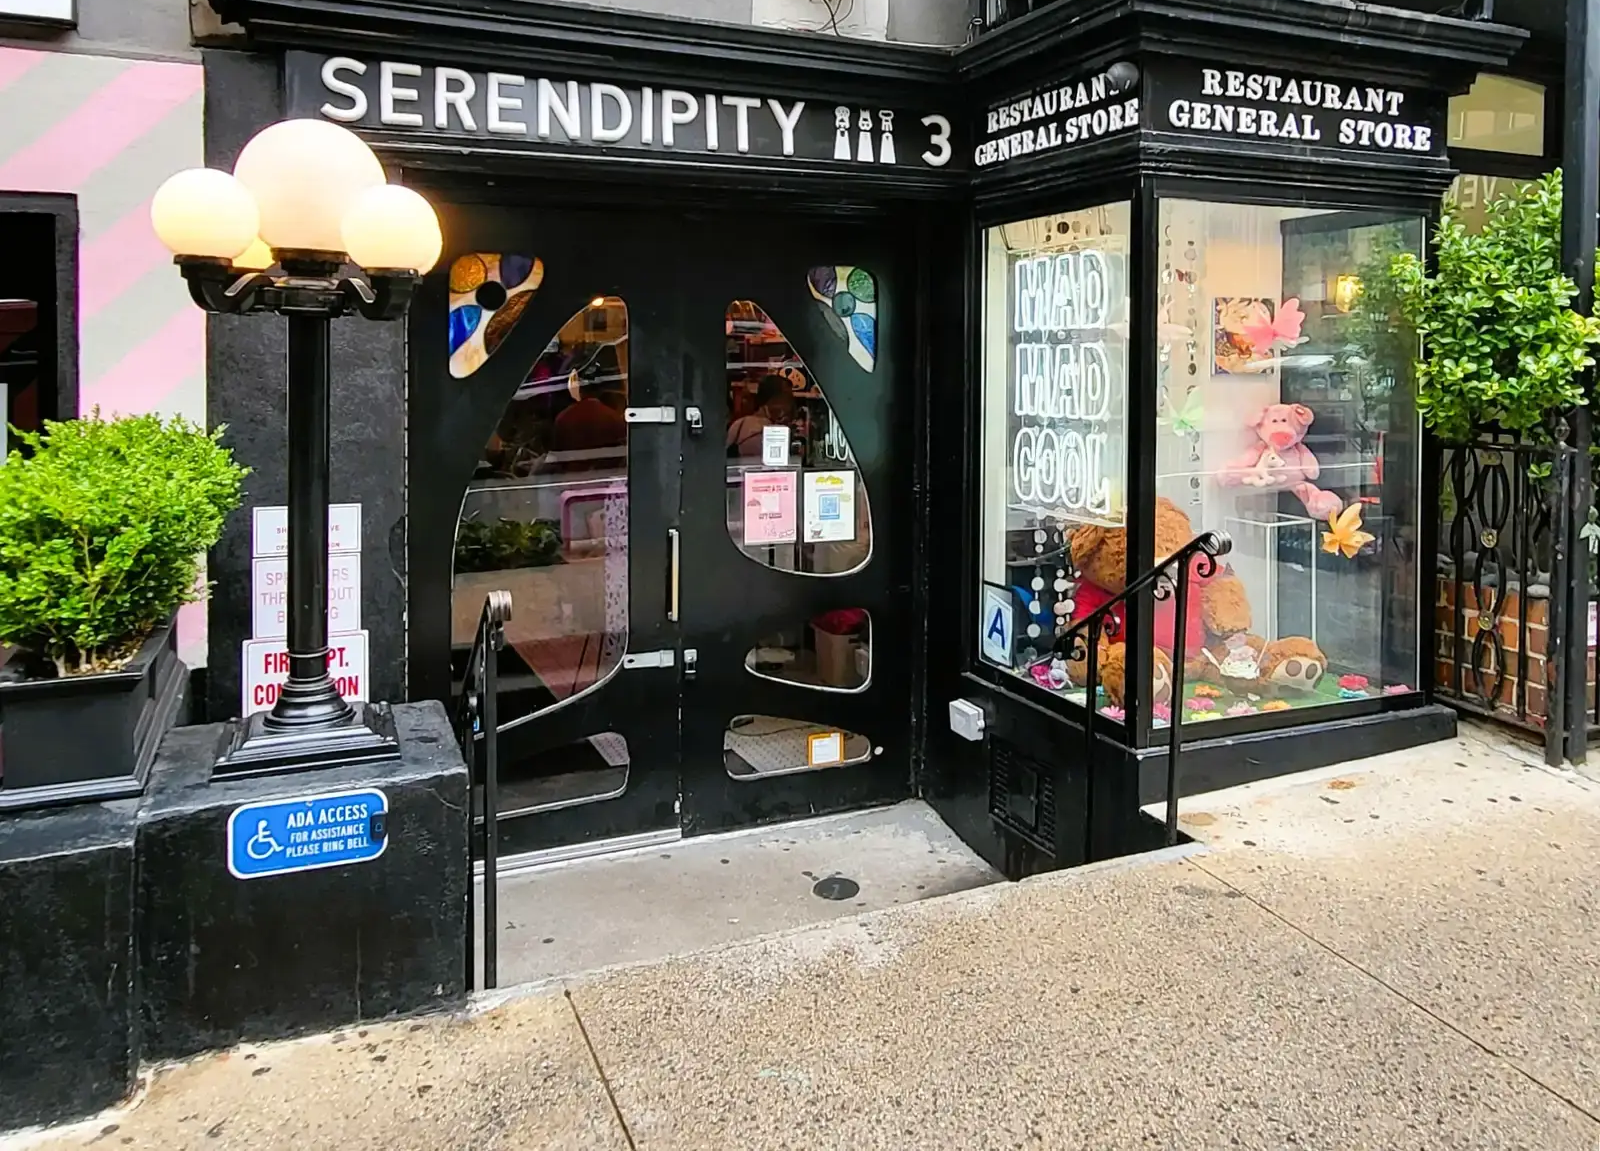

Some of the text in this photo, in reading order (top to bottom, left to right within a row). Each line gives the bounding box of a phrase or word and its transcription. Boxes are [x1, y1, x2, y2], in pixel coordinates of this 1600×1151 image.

[320, 56, 952, 167] SERENDIPITY 3
[1201, 68, 1404, 116] RESTAURANT
[974, 98, 1139, 166] GENERAL STORE
[1168, 99, 1432, 151] GENERAL STORE
[1013, 426, 1111, 514] COOL
[987, 607, 1006, 650] A
[287, 803, 368, 829] ADA ACCESS
[290, 822, 365, 844] FOR ASSISTANCE
[286, 836, 369, 858] PLEASE RING BELL
